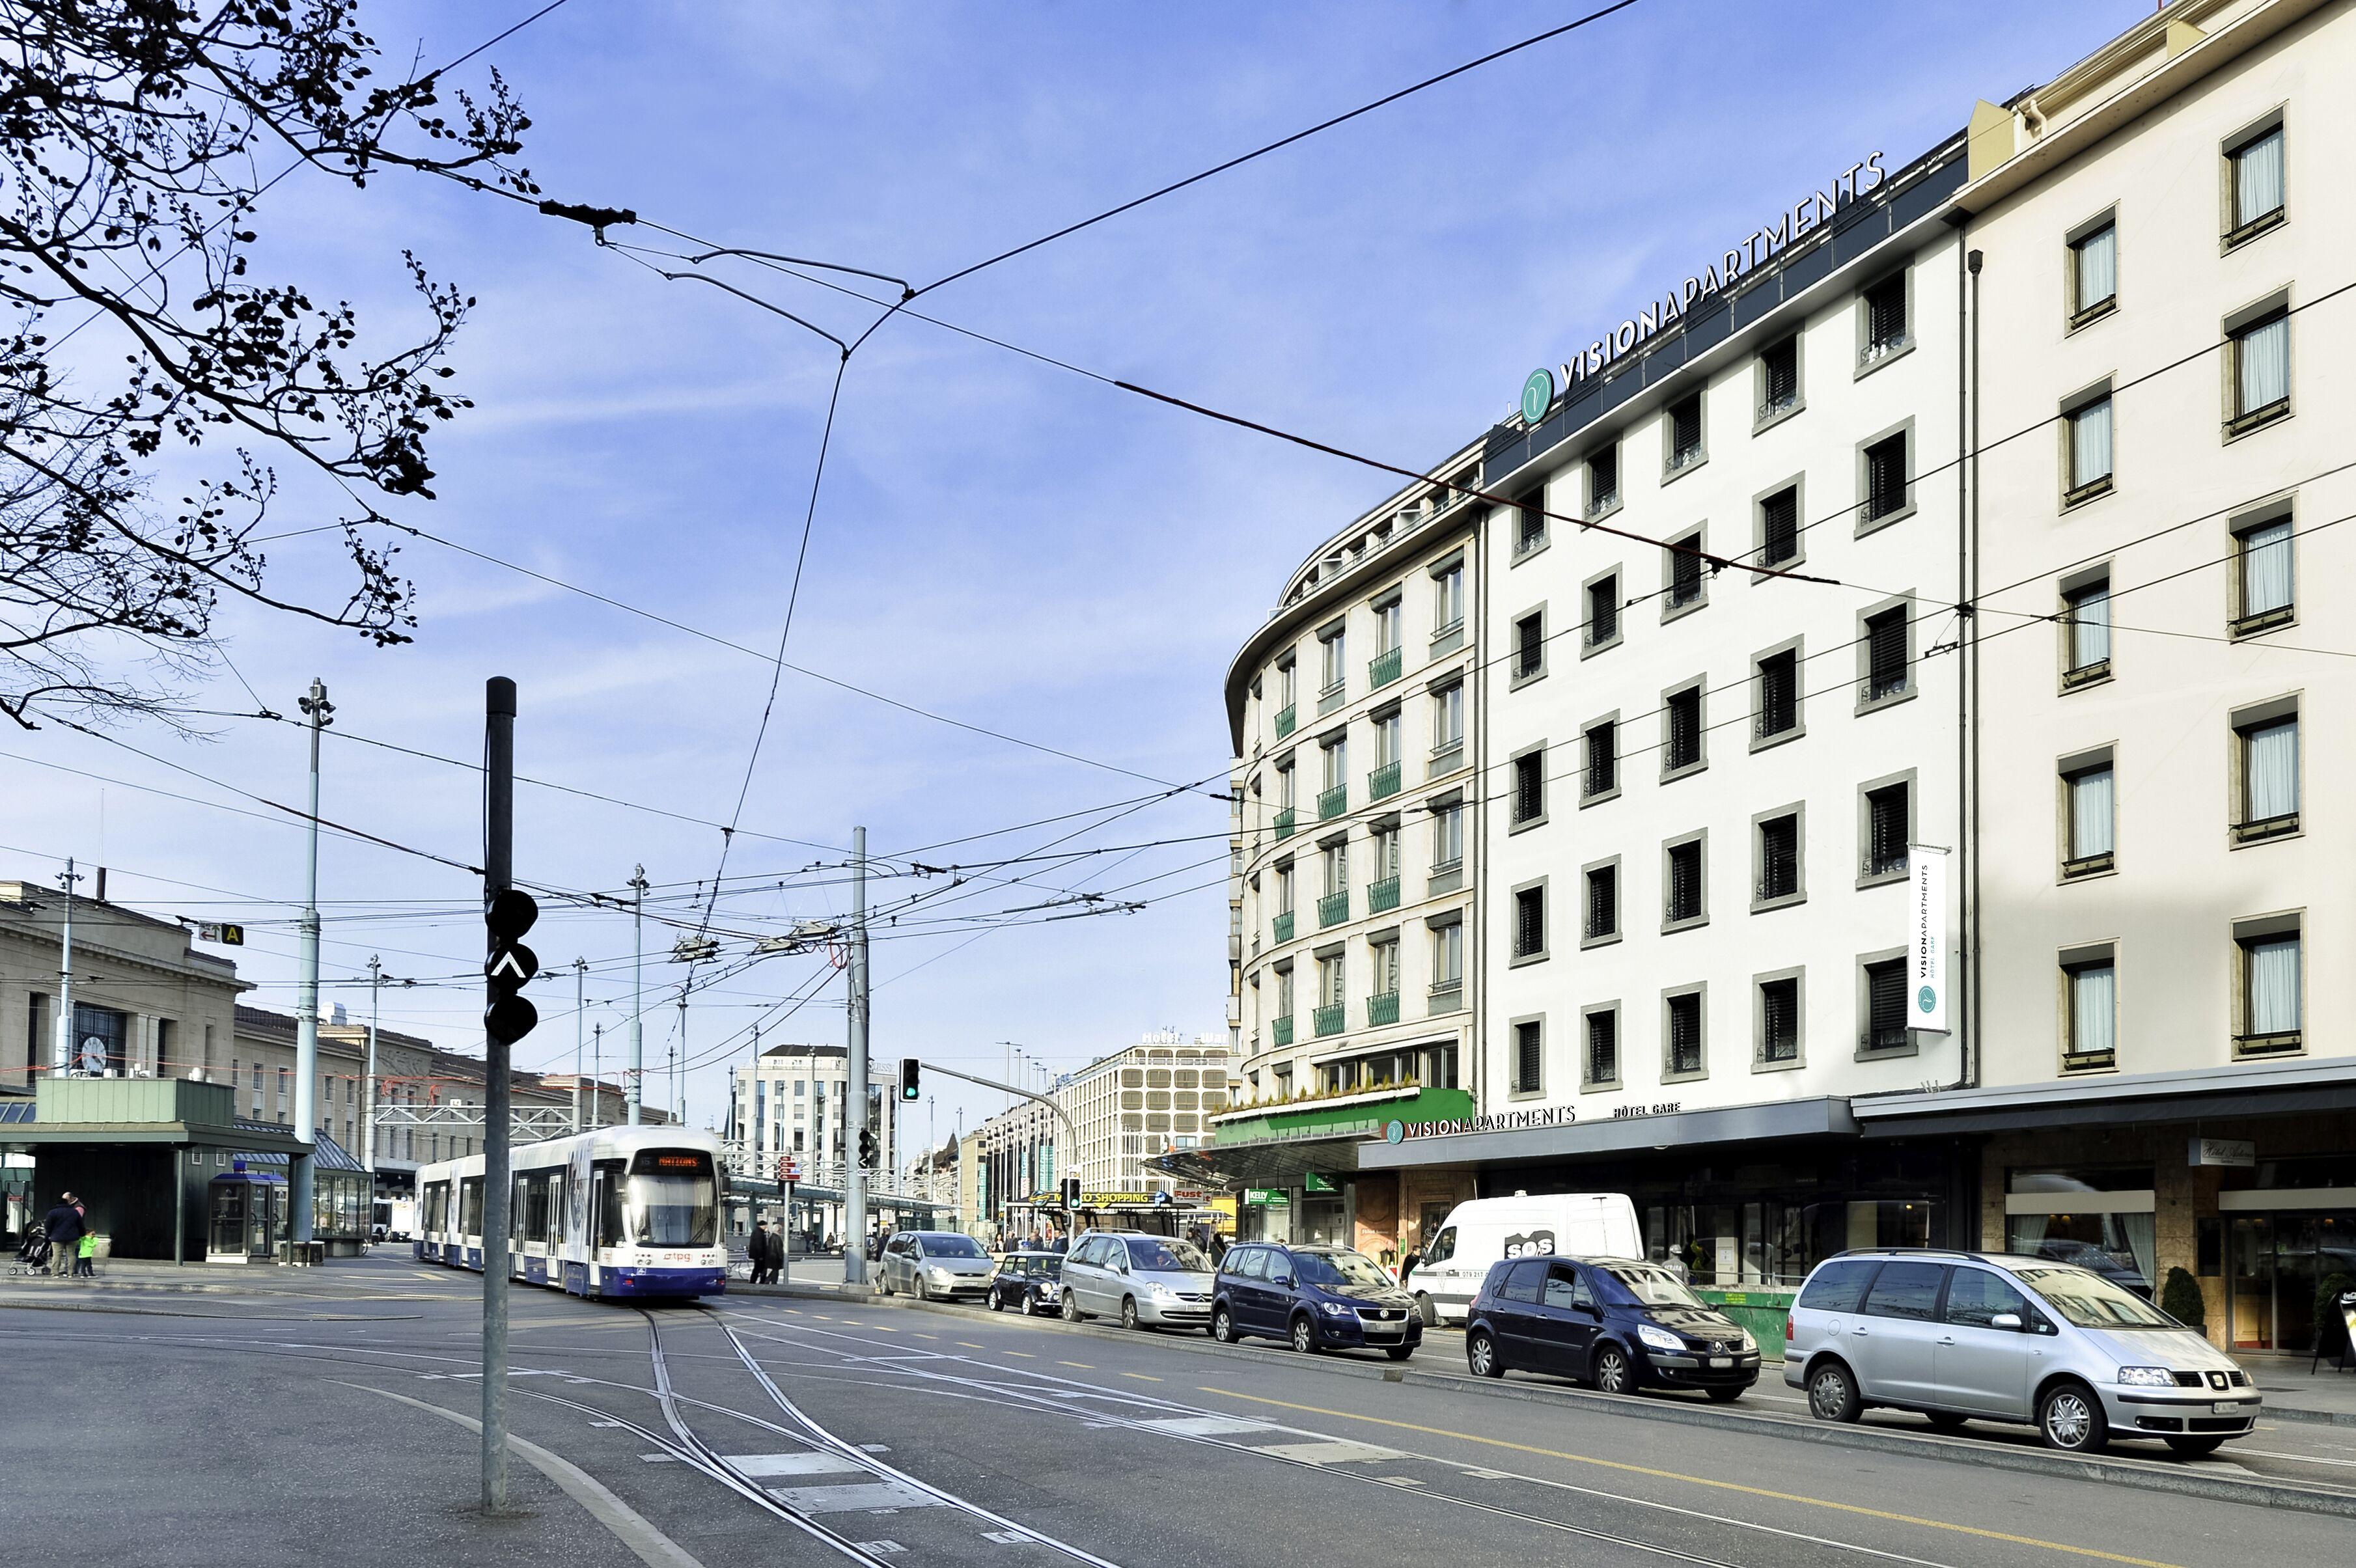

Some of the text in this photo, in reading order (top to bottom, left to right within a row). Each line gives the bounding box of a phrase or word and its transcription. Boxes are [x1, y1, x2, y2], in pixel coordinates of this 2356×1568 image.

[1559, 151, 1885, 391] VISIONAPARTMENTS
[227, 927, 239, 942] A
[1613, 1102, 1681, 1118] HÔTEL GARE
[1407, 1105, 1575, 1138] VISIONAPARTMENTS
[1096, 1193, 1148, 1203] SHOPPING
[1507, 1238, 1553, 1259] SOS
